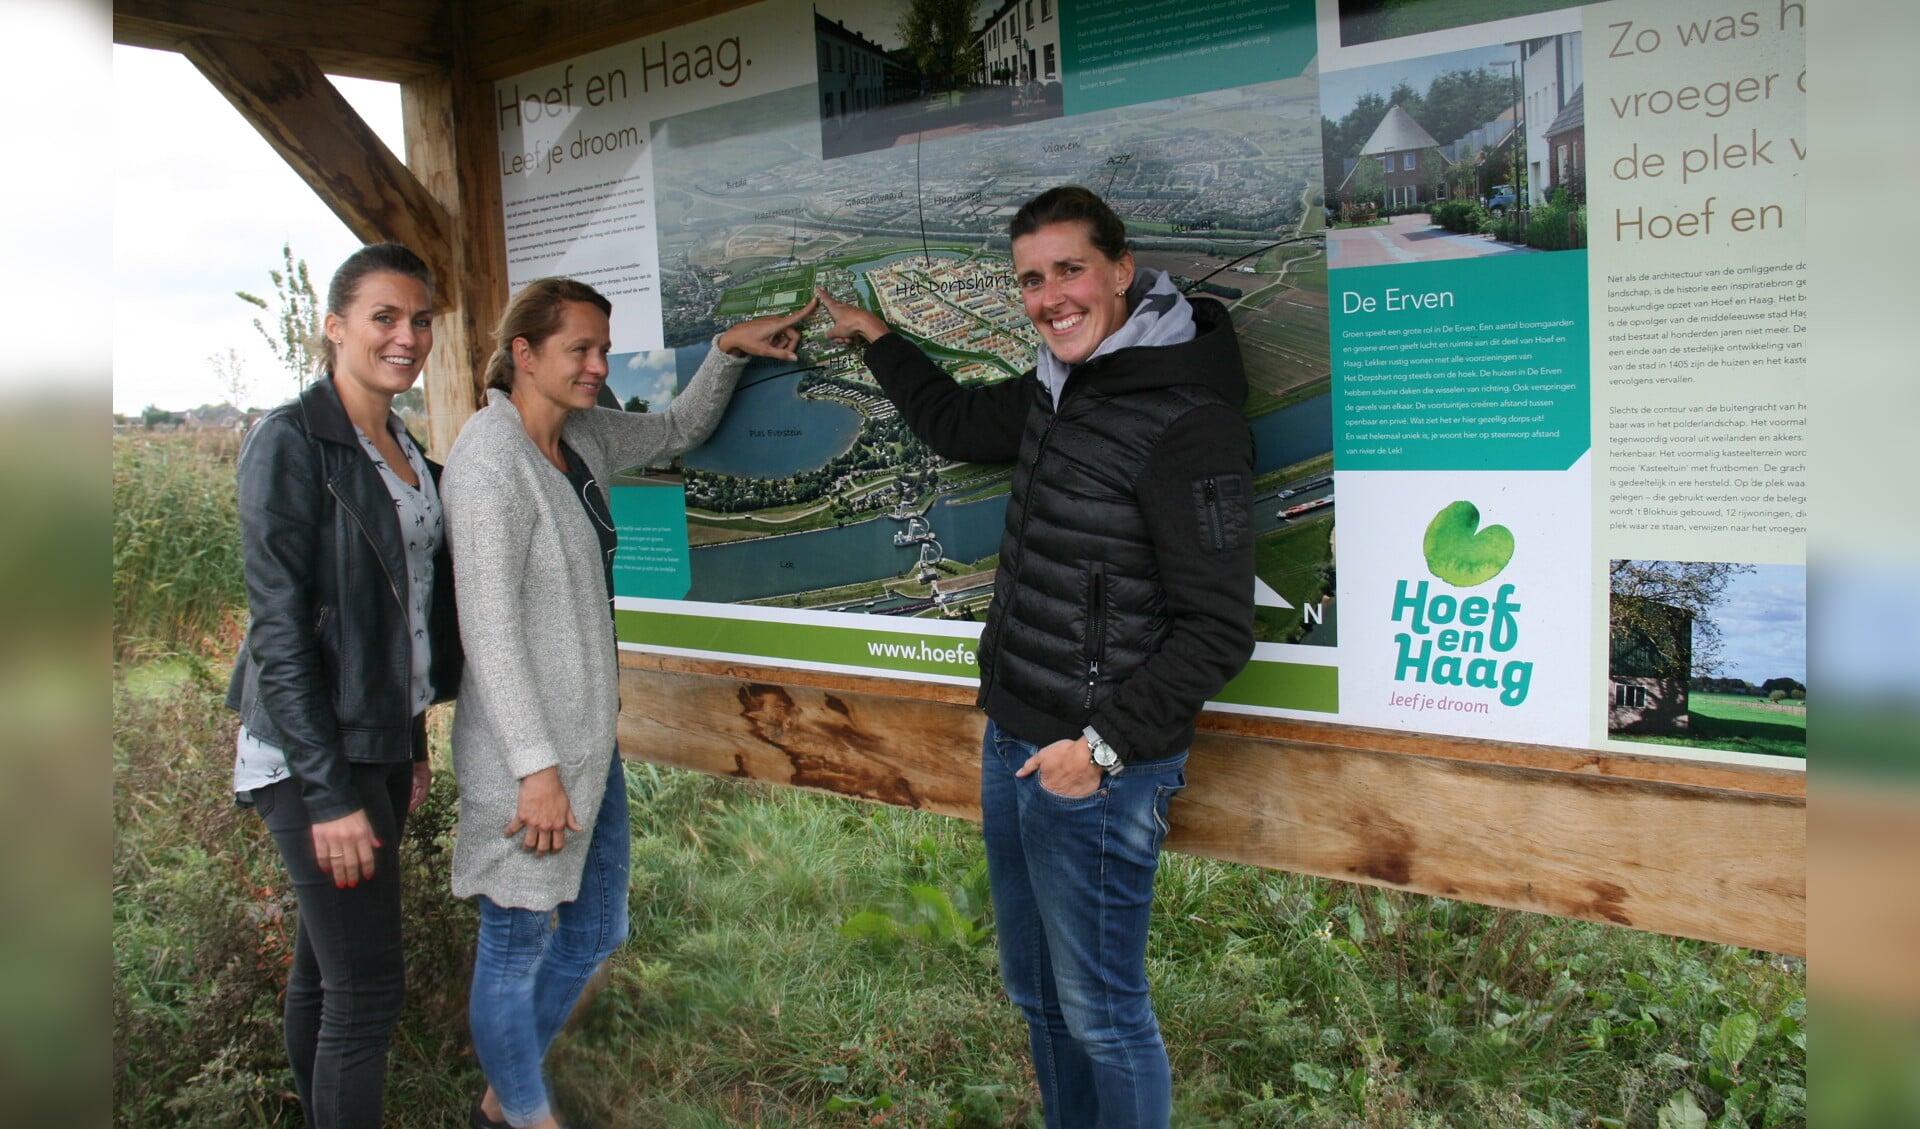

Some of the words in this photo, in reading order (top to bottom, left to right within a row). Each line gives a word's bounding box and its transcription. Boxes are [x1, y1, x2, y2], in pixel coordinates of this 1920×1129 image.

[1608, 20, 1661, 58] Zo
[1677, 12, 1760, 47] was
[498, 64, 574, 131] Hoef
[586, 68, 626, 106] en
[642, 36, 752, 92] Haag.
[1610, 74, 1780, 119] vroeger
[501, 140, 541, 176] Leef
[546, 142, 563, 174] je
[570, 126, 644, 160] droom.
[1105, 153, 1134, 167] A27
[1613, 143, 1665, 180] de
[1682, 128, 1775, 184] plek
[1616, 197, 1716, 242] Hoef
[1731, 204, 1783, 232] en
[896, 280, 923, 297] Het
[928, 272, 1012, 298] Dorpshart
[1662, 286, 1674, 294] de
[1676, 285, 1708, 293] historie
[1730, 280, 1793, 291] inspiratiebron
[1343, 291, 1376, 314] De
[1386, 288, 1454, 312] Erven
[1342, 330, 1364, 338] Groen
[1365, 328, 1386, 338] speelt
[1402, 328, 1421, 337] grote
[1422, 326, 1432, 334] rol
[1442, 325, 1453, 333] De
[1494, 322, 1518, 330] aantal
[1519, 320, 1574, 330] boomgaarden
[1608, 333, 1626, 341] stad
[1627, 332, 1658, 340] bestaat
[1661, 331, 1668, 339] al
[1670, 330, 1718, 338] honderden
[1720, 330, 1742, 338] jaren
[1626, 347, 1649, 355] einde
[1683, 344, 1724, 354] stedelijke
[1726, 342, 1783, 351] ontwikkeling
[830, 353, 854, 370] Het
[1364, 358, 1387, 367] Lekker
[1388, 358, 1408, 367] rustig
[1434, 356, 1449, 364] met
[1450, 355, 1464, 363] alle
[1464, 354, 1517, 363] voorzieningen
[1344, 374, 1356, 382] Het
[1357, 373, 1391, 383] Dorpshart
[1392, 374, 1407, 382] nog
[1408, 371, 1432, 379] steeds
[1446, 370, 1456, 378] de
[1479, 369, 1491, 377] De
[1540, 367, 1562, 375] Erven
[1608, 377, 1653, 386] vervolgens
[1344, 388, 1370, 396] hebben
[1371, 387, 1398, 395] schuine
[1399, 386, 1421, 394] daken
[1422, 386, 1434, 394] die
[1435, 385, 1465, 393] wisselen
[1512, 383, 1529, 391] Ook
[1530, 383, 1576, 392] verspringen
[1344, 403, 1354, 411] de
[1355, 402, 1377, 412] gevels
[1415, 401, 1426, 409] De
[1427, 401, 1469, 410] voortuintjes
[1500, 399, 1527, 407] afstand
[1657, 420, 1670, 428] het
[1345, 432, 1354, 440] En
[1369, 432, 1400, 440] helemaal
[1431, 432, 1438, 441] je
[1463, 431, 1477, 439] hier
[1490, 431, 1530, 440] steenworp
[1531, 430, 1559, 438] afstand
[1609, 435, 1667, 445] tegenwoordig
[1669, 434, 1695, 442] vooral
[1711, 434, 1756, 442] weilanden
[1387, 446, 1402, 454] Lek!
[1304, 603, 1323, 625] N
[1391, 580, 1521, 652] Hoef
[1438, 629, 1484, 653] en
[868, 640, 978, 666] www.hoefe
[1394, 634, 1534, 708] Haag
[1390, 691, 1417, 710] leef
[1418, 694, 1434, 712] je
[1438, 696, 1489, 714] droom
